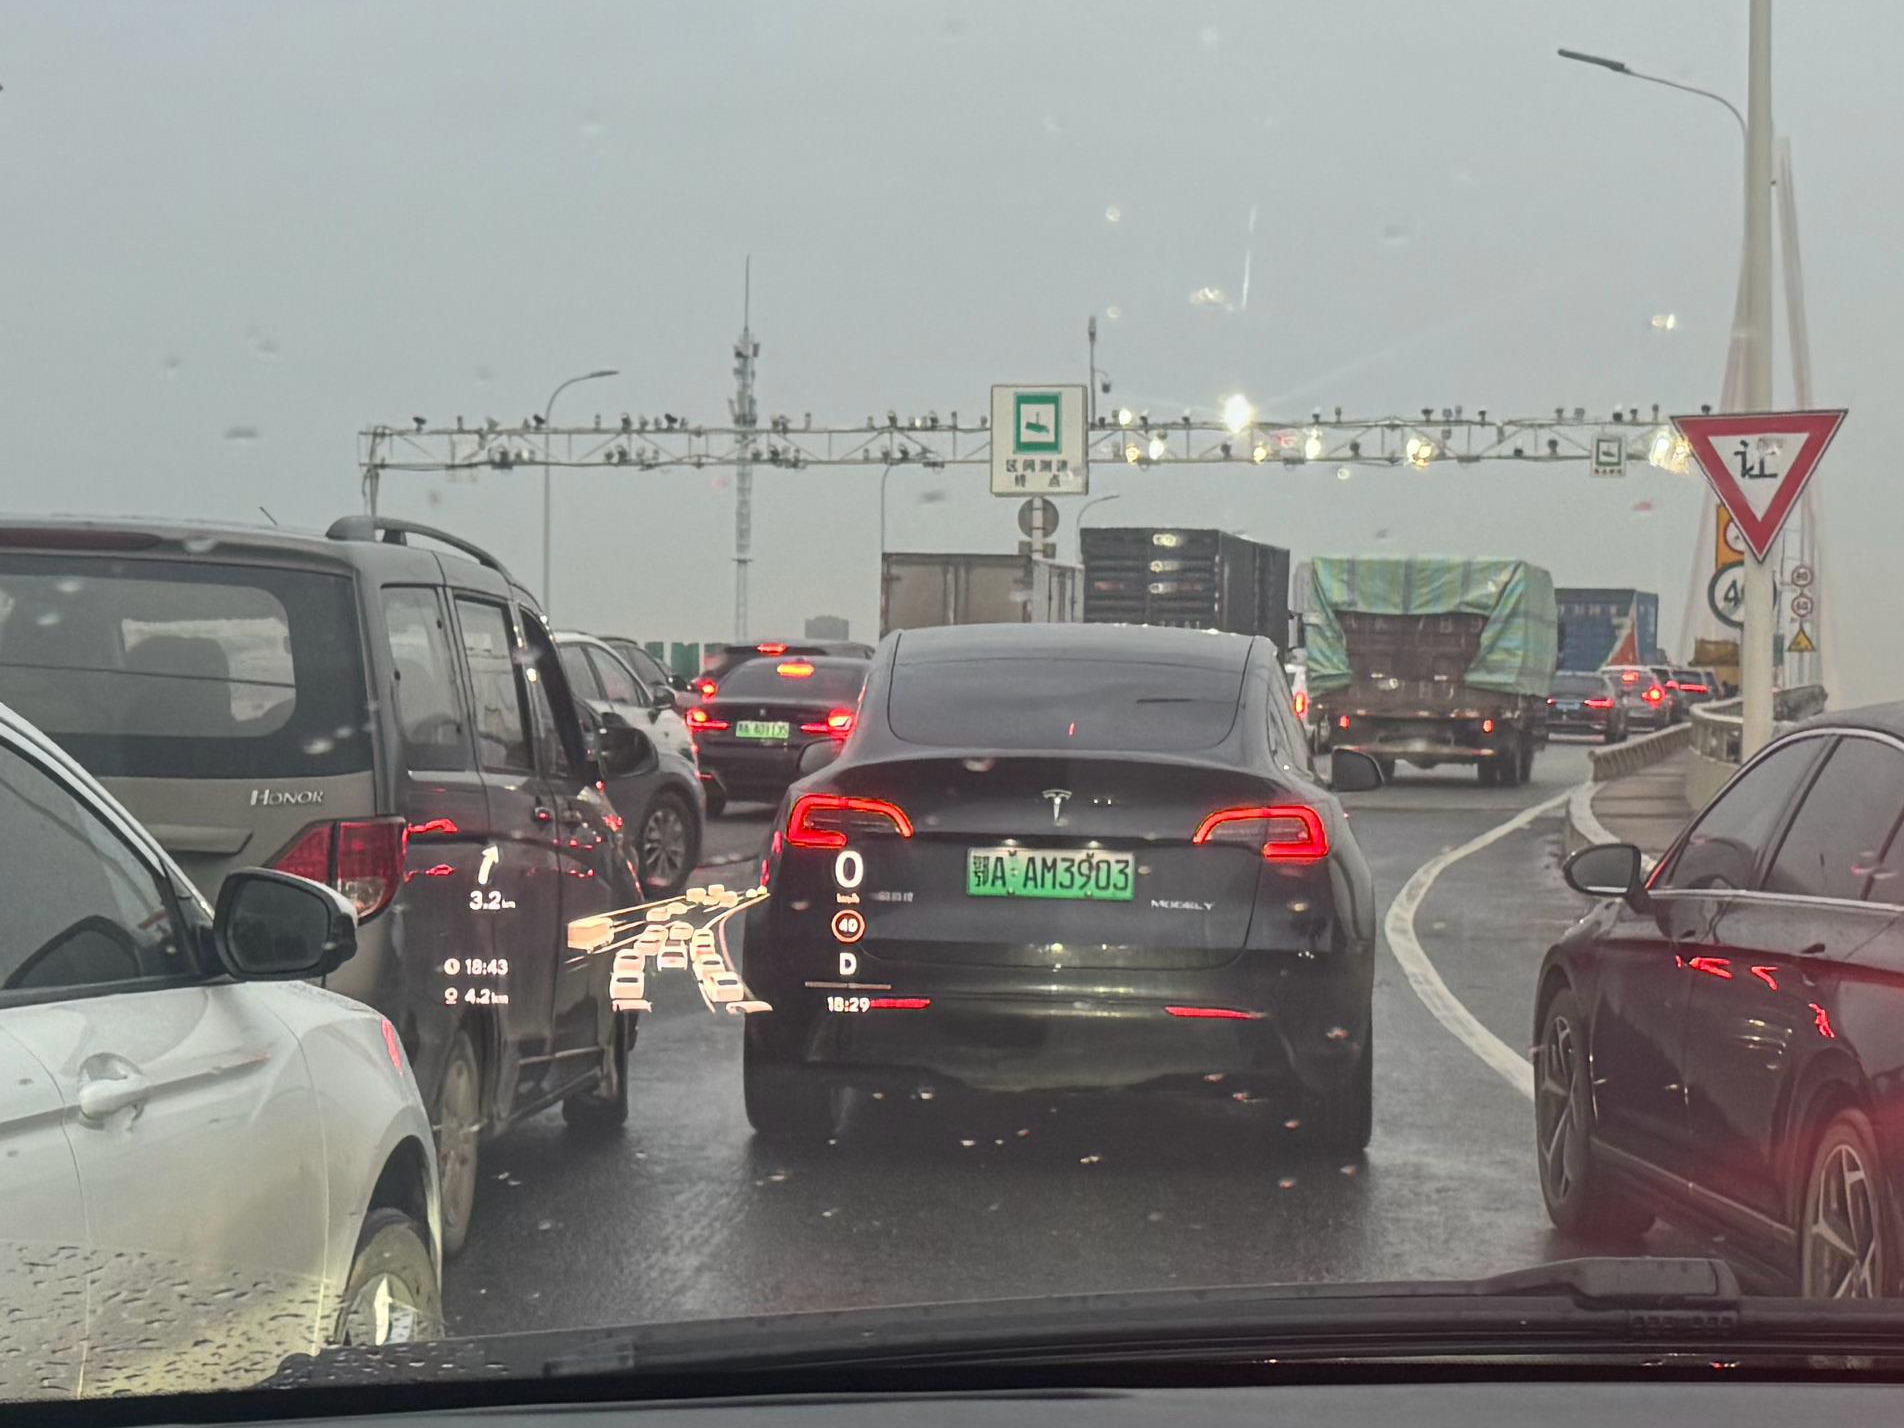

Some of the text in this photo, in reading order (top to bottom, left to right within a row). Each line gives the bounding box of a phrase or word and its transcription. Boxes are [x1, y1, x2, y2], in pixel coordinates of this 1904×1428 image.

[1734, 440, 1778, 479] 让
[1723, 579, 1744, 608] 4
[250, 788, 324, 806] HONOR
[835, 850, 864, 888] 0
[838, 918, 858, 933] 40
[465, 959, 509, 975] 18:43
[839, 952, 857, 975] D
[827, 997, 870, 1012] 18:29
